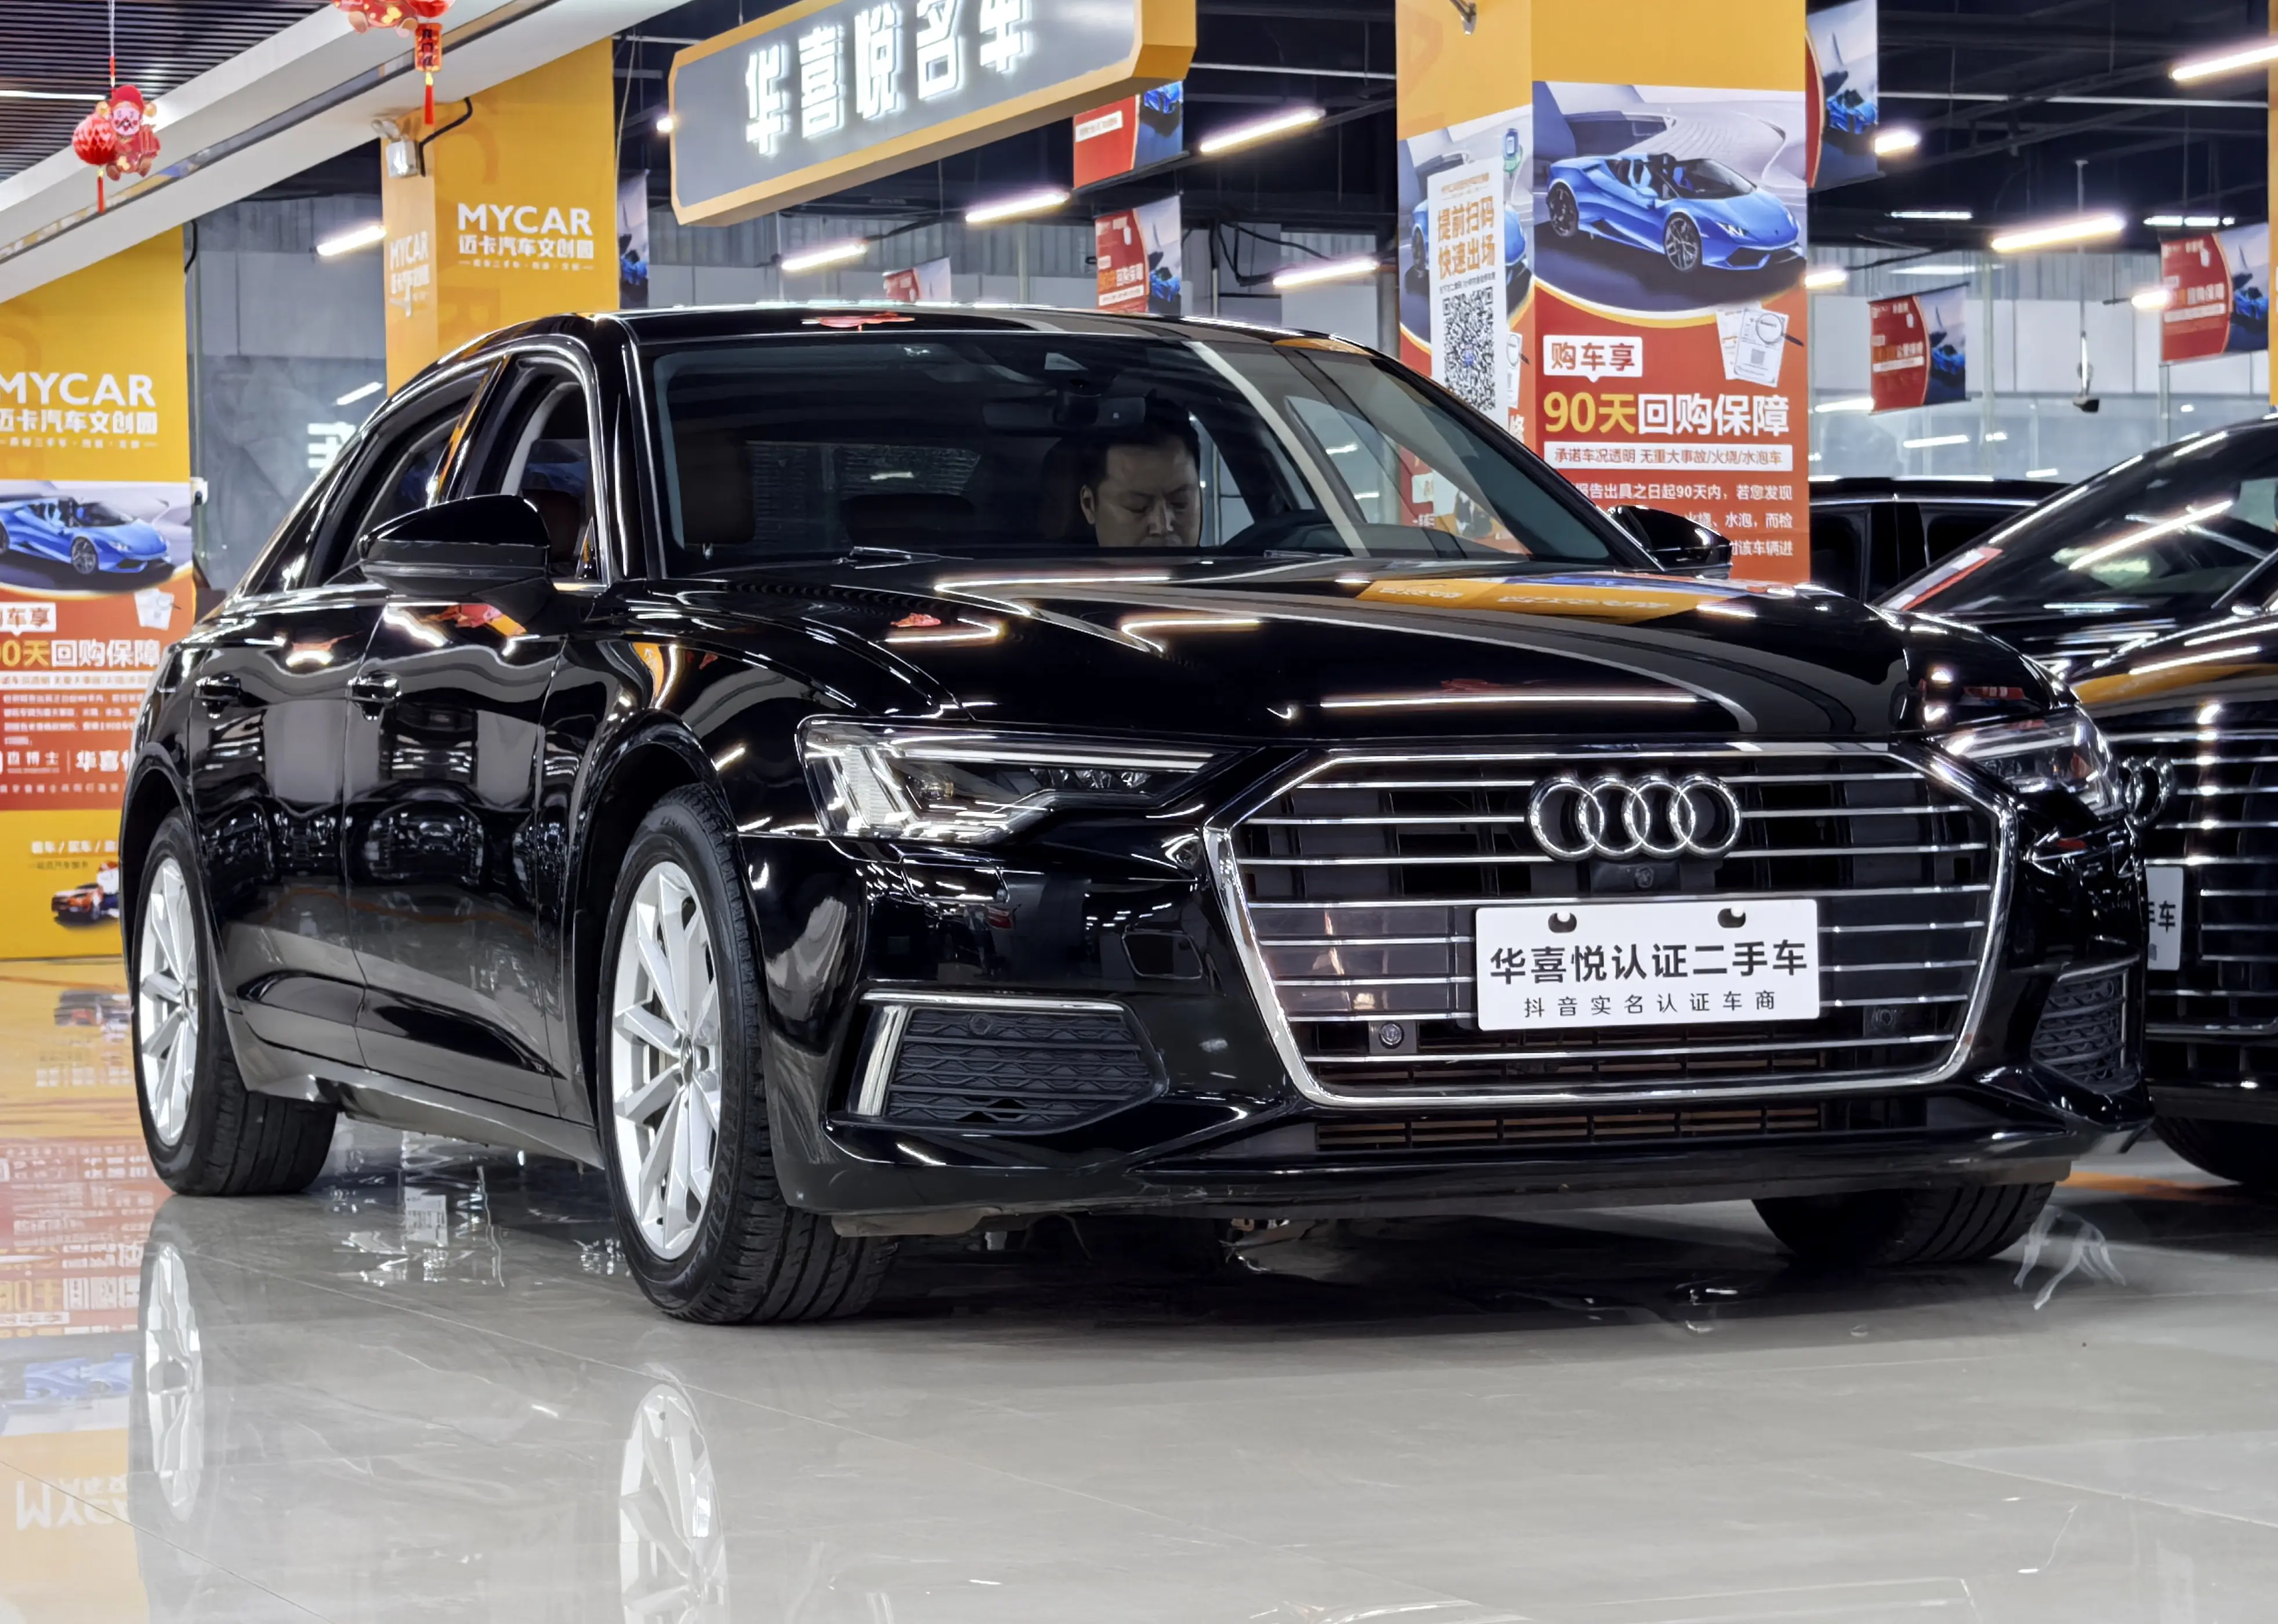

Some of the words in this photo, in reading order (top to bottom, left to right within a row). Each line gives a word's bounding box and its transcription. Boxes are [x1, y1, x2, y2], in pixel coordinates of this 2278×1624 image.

[458, 203, 593, 236] MYCAR
[1437, 196, 1494, 242] 提前扫码
[1439, 233, 1495, 280] 快速出场
[1551, 342, 1636, 372] 购车享
[0, 372, 156, 407] MYCAR
[1543, 392, 1790, 437] 90天回购保障
[1555, 447, 1636, 463] 承诺车况透明
[1640, 448, 1783, 465] 无重大事故/火烧/水泡车
[0, 607, 50, 627] 车享
[0, 639, 160, 668] 0天回购保障
[1490, 939, 1808, 985] 华喜悦认证二手车
[1523, 989, 1776, 1018] 抖音实名认证车商
